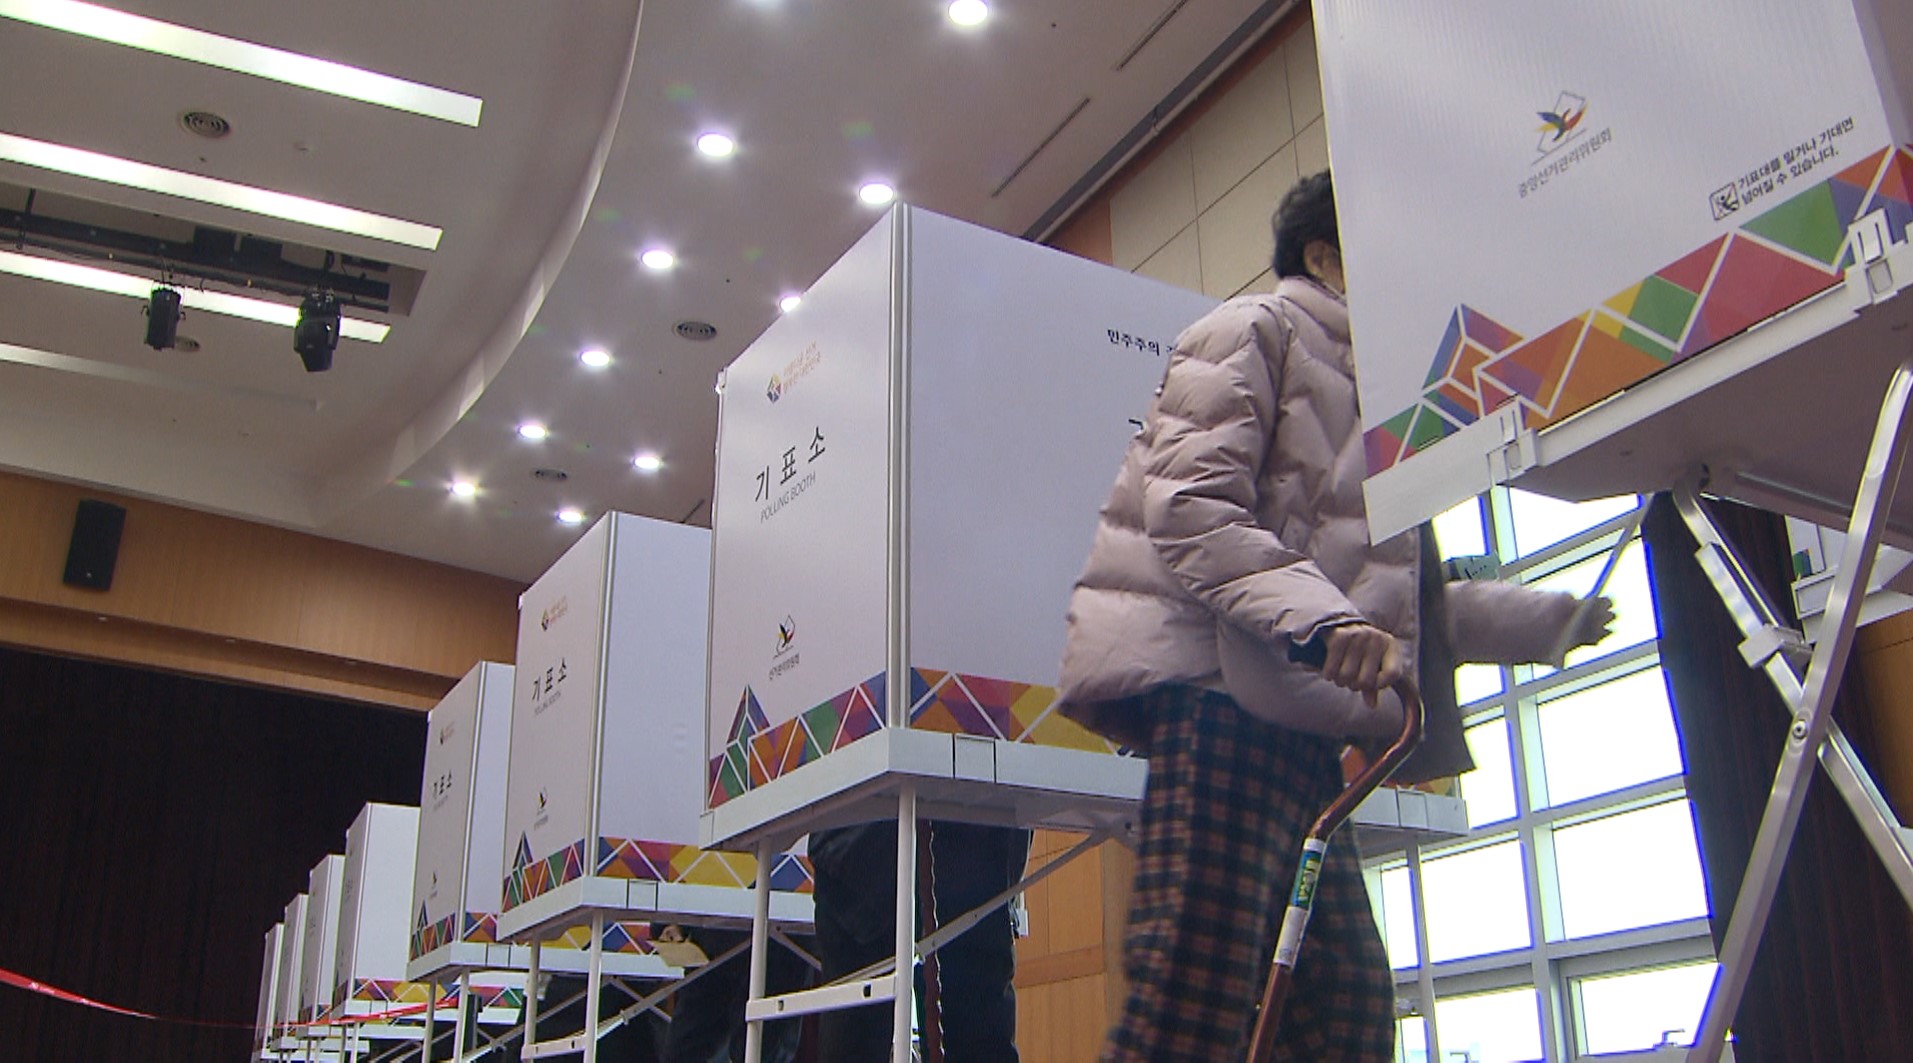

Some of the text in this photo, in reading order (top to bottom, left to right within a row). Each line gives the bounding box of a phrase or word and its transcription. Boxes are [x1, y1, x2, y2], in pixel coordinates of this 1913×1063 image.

[1518, 127, 1612, 198] 중앙선거관리위원회
[1738, 116, 1854, 189] 기표대를 밀거나 기대면
[1741, 145, 1839, 205] 넘어질 수 있습니다.
[1107, 328, 1160, 356] 민주주의
[761, 470, 816, 524] POLLING BOOTH
